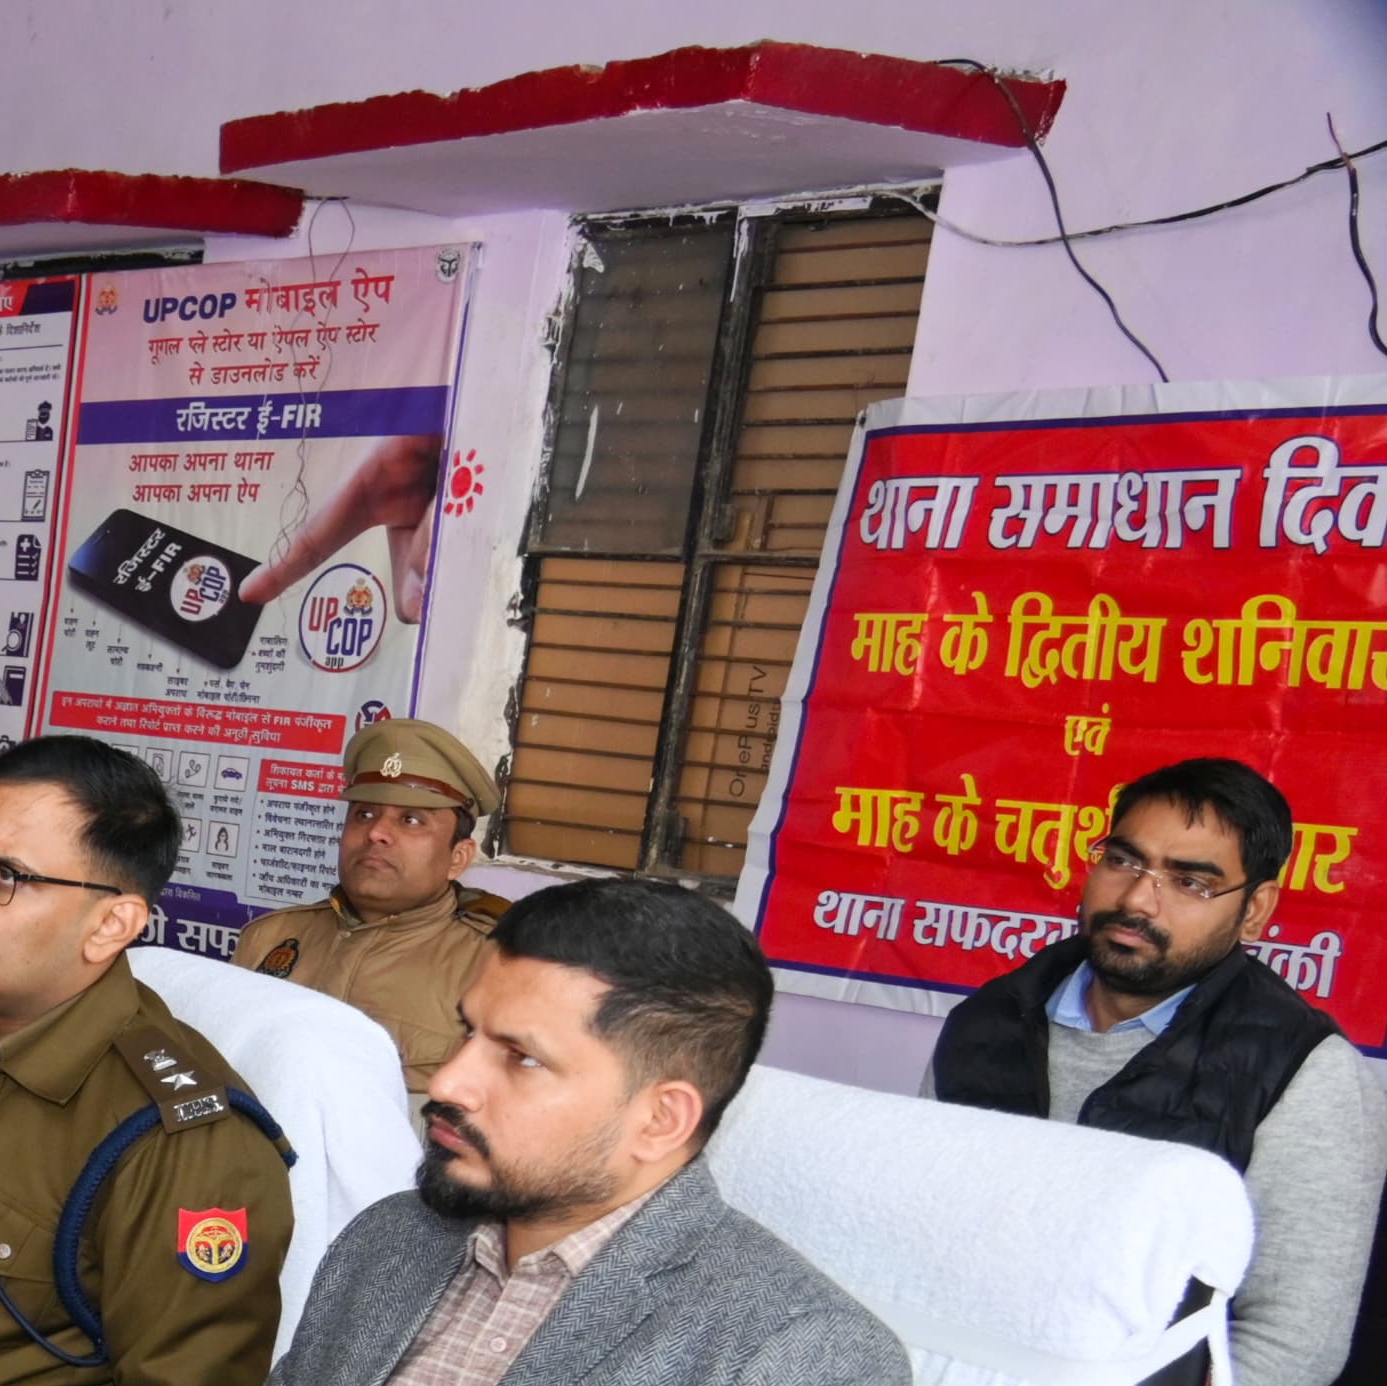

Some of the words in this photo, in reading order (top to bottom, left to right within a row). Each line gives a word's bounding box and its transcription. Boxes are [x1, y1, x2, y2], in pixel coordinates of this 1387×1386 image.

[142, 292, 237, 323] UPCOP
[245, 277, 340, 316] मोबाइल
[351, 267, 395, 312] ऐप
[148, 337, 180, 365] गूगल
[188, 330, 208, 354] प्ले
[212, 328, 243, 353] स्टोर
[247, 332, 266, 350] या
[346, 320, 380, 344] स्टोर
[189, 362, 205, 385] से
[211, 359, 288, 385] डाउनलोड
[293, 355, 321, 381] करें
[176, 402, 251, 432] रजिस्टर
[257, 401, 322, 433] ई-FIR
[129, 453, 178, 472] आपका
[183, 453, 227, 472] अपना
[234, 452, 275, 471] थाना
[133, 484, 182, 503] आपका
[187, 483, 231, 502] अपना
[237, 477, 260, 503] ऐप
[860, 475, 979, 550] थाना
[987, 466, 1242, 550] समाधान
[1259, 435, 1387, 555] दिव
[180, 588, 204, 615] UP
[199, 566, 226, 602] COP
[308, 597, 339, 633] UP
[326, 617, 373, 656] COP
[851, 612, 930, 676] माह
[939, 591, 993, 676] के
[1004, 591, 1167, 688] द्वितीय
[325, 656, 344, 669] app
[1063, 703, 1112, 756] एवं
[729, 702, 761, 798] OnePus
[290, 780, 315, 792] SMS
[831, 786, 924, 853] माह
[932, 773, 981, 857] के
[813, 889, 904, 942] थाना
[912, 898, 1080, 961] सफदर
